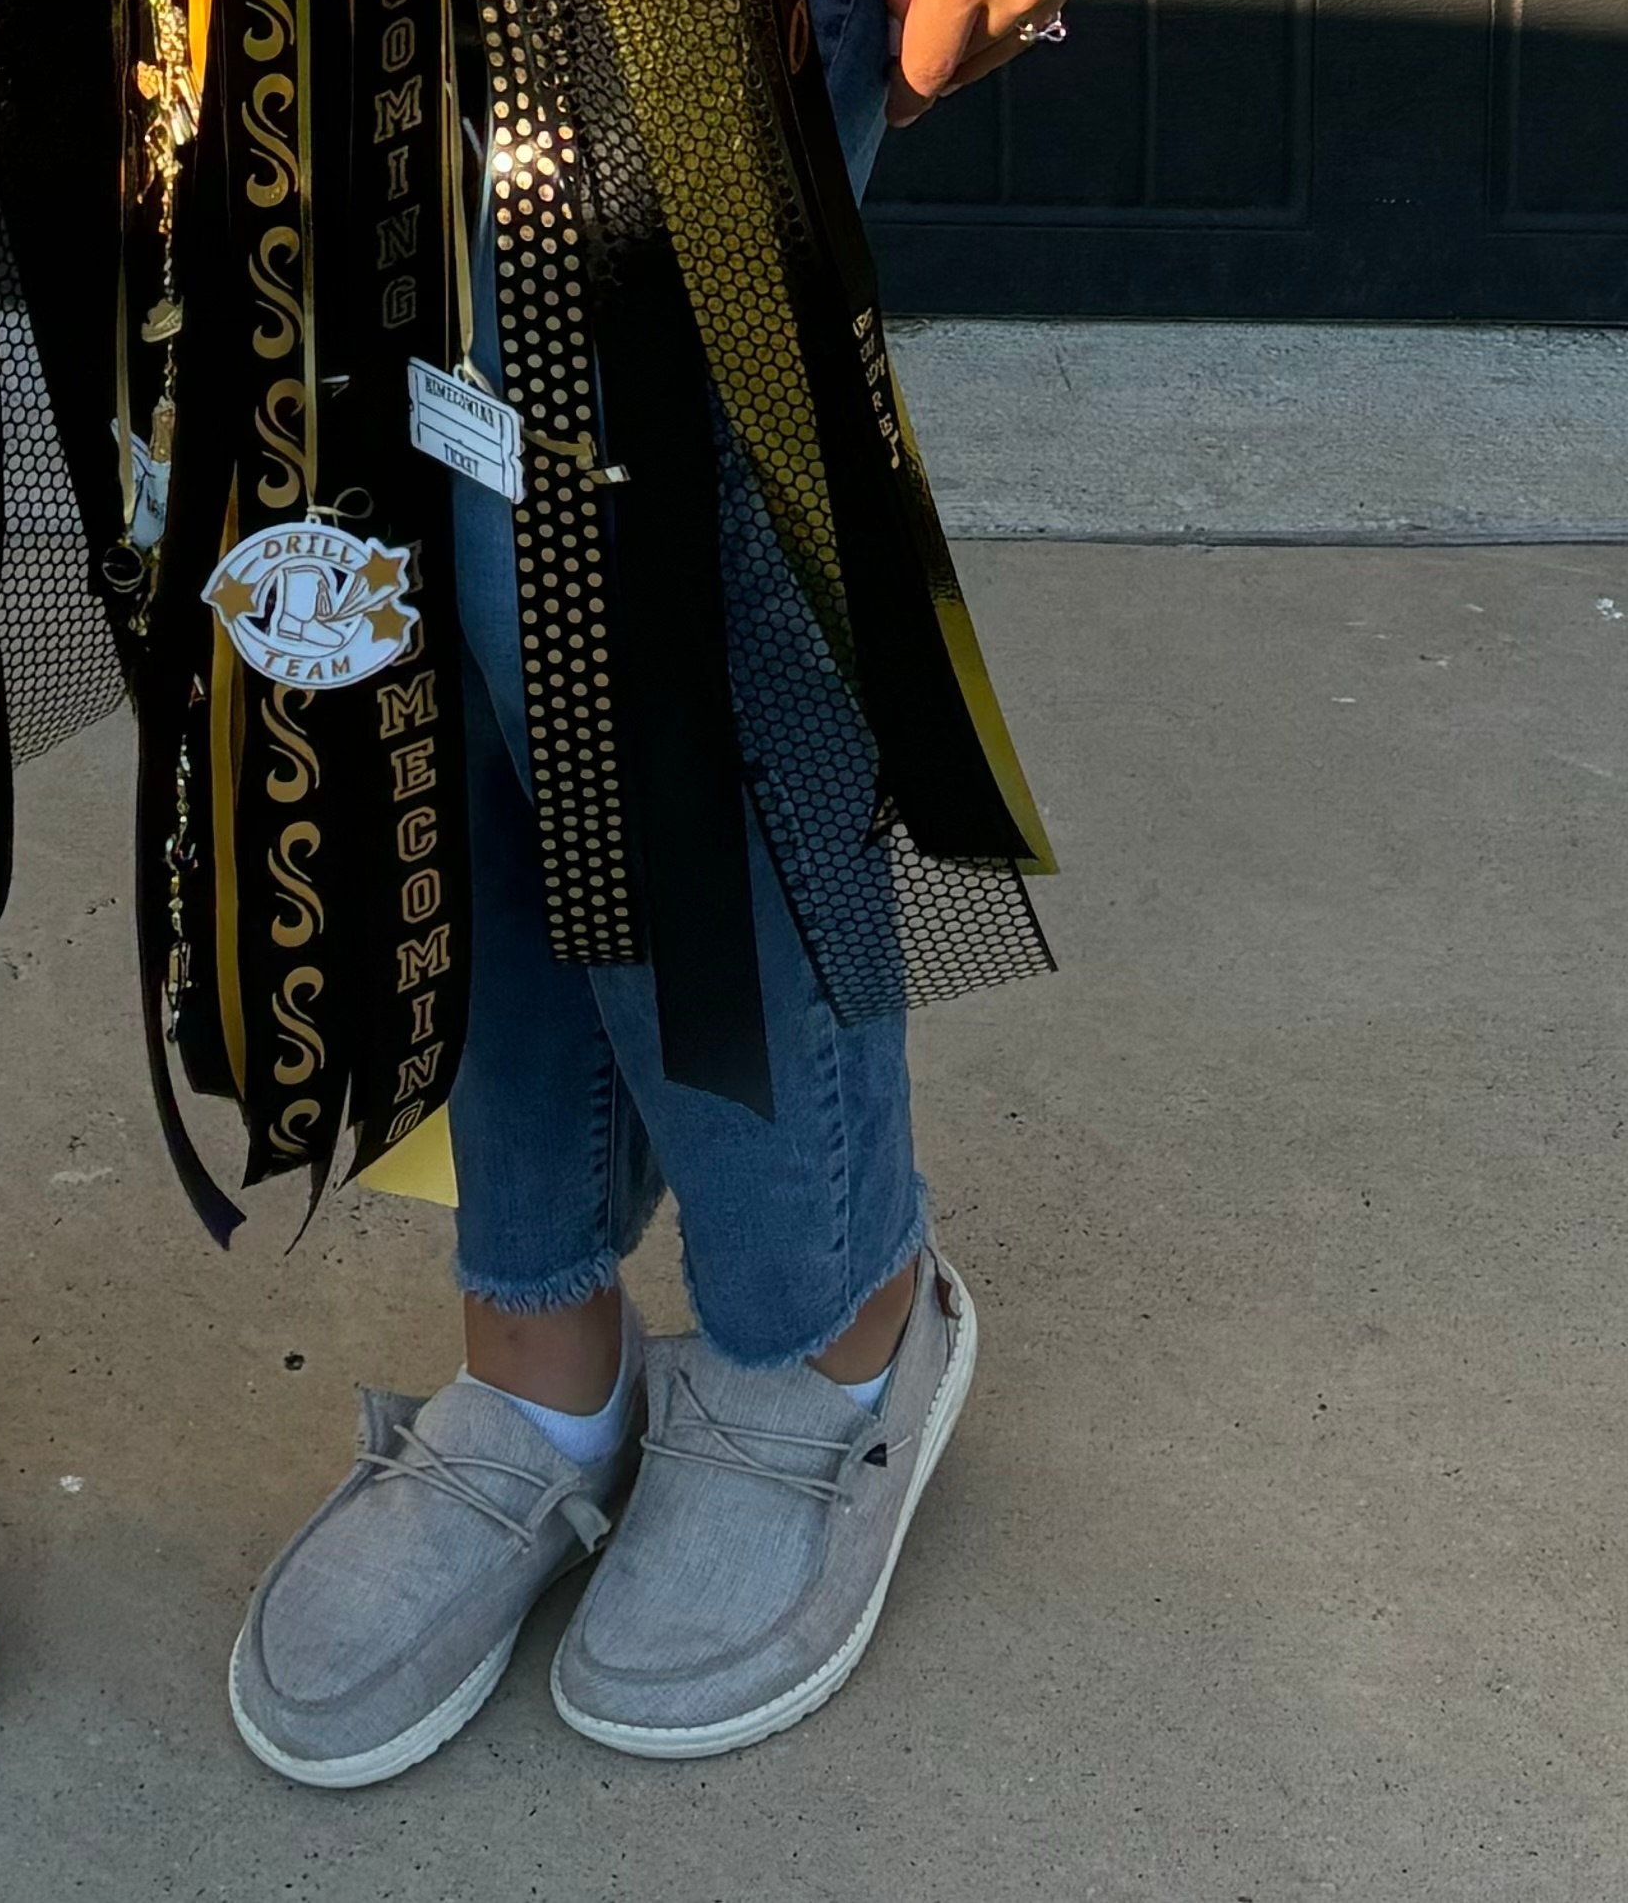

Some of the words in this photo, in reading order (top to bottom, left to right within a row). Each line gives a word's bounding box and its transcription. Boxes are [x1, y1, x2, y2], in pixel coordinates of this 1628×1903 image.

[443, 442, 480, 478] TICKET
[262, 534, 354, 565] DRILL
[263, 649, 352, 681] TEAM
[379, 538, 452, 1145] MECOMING
